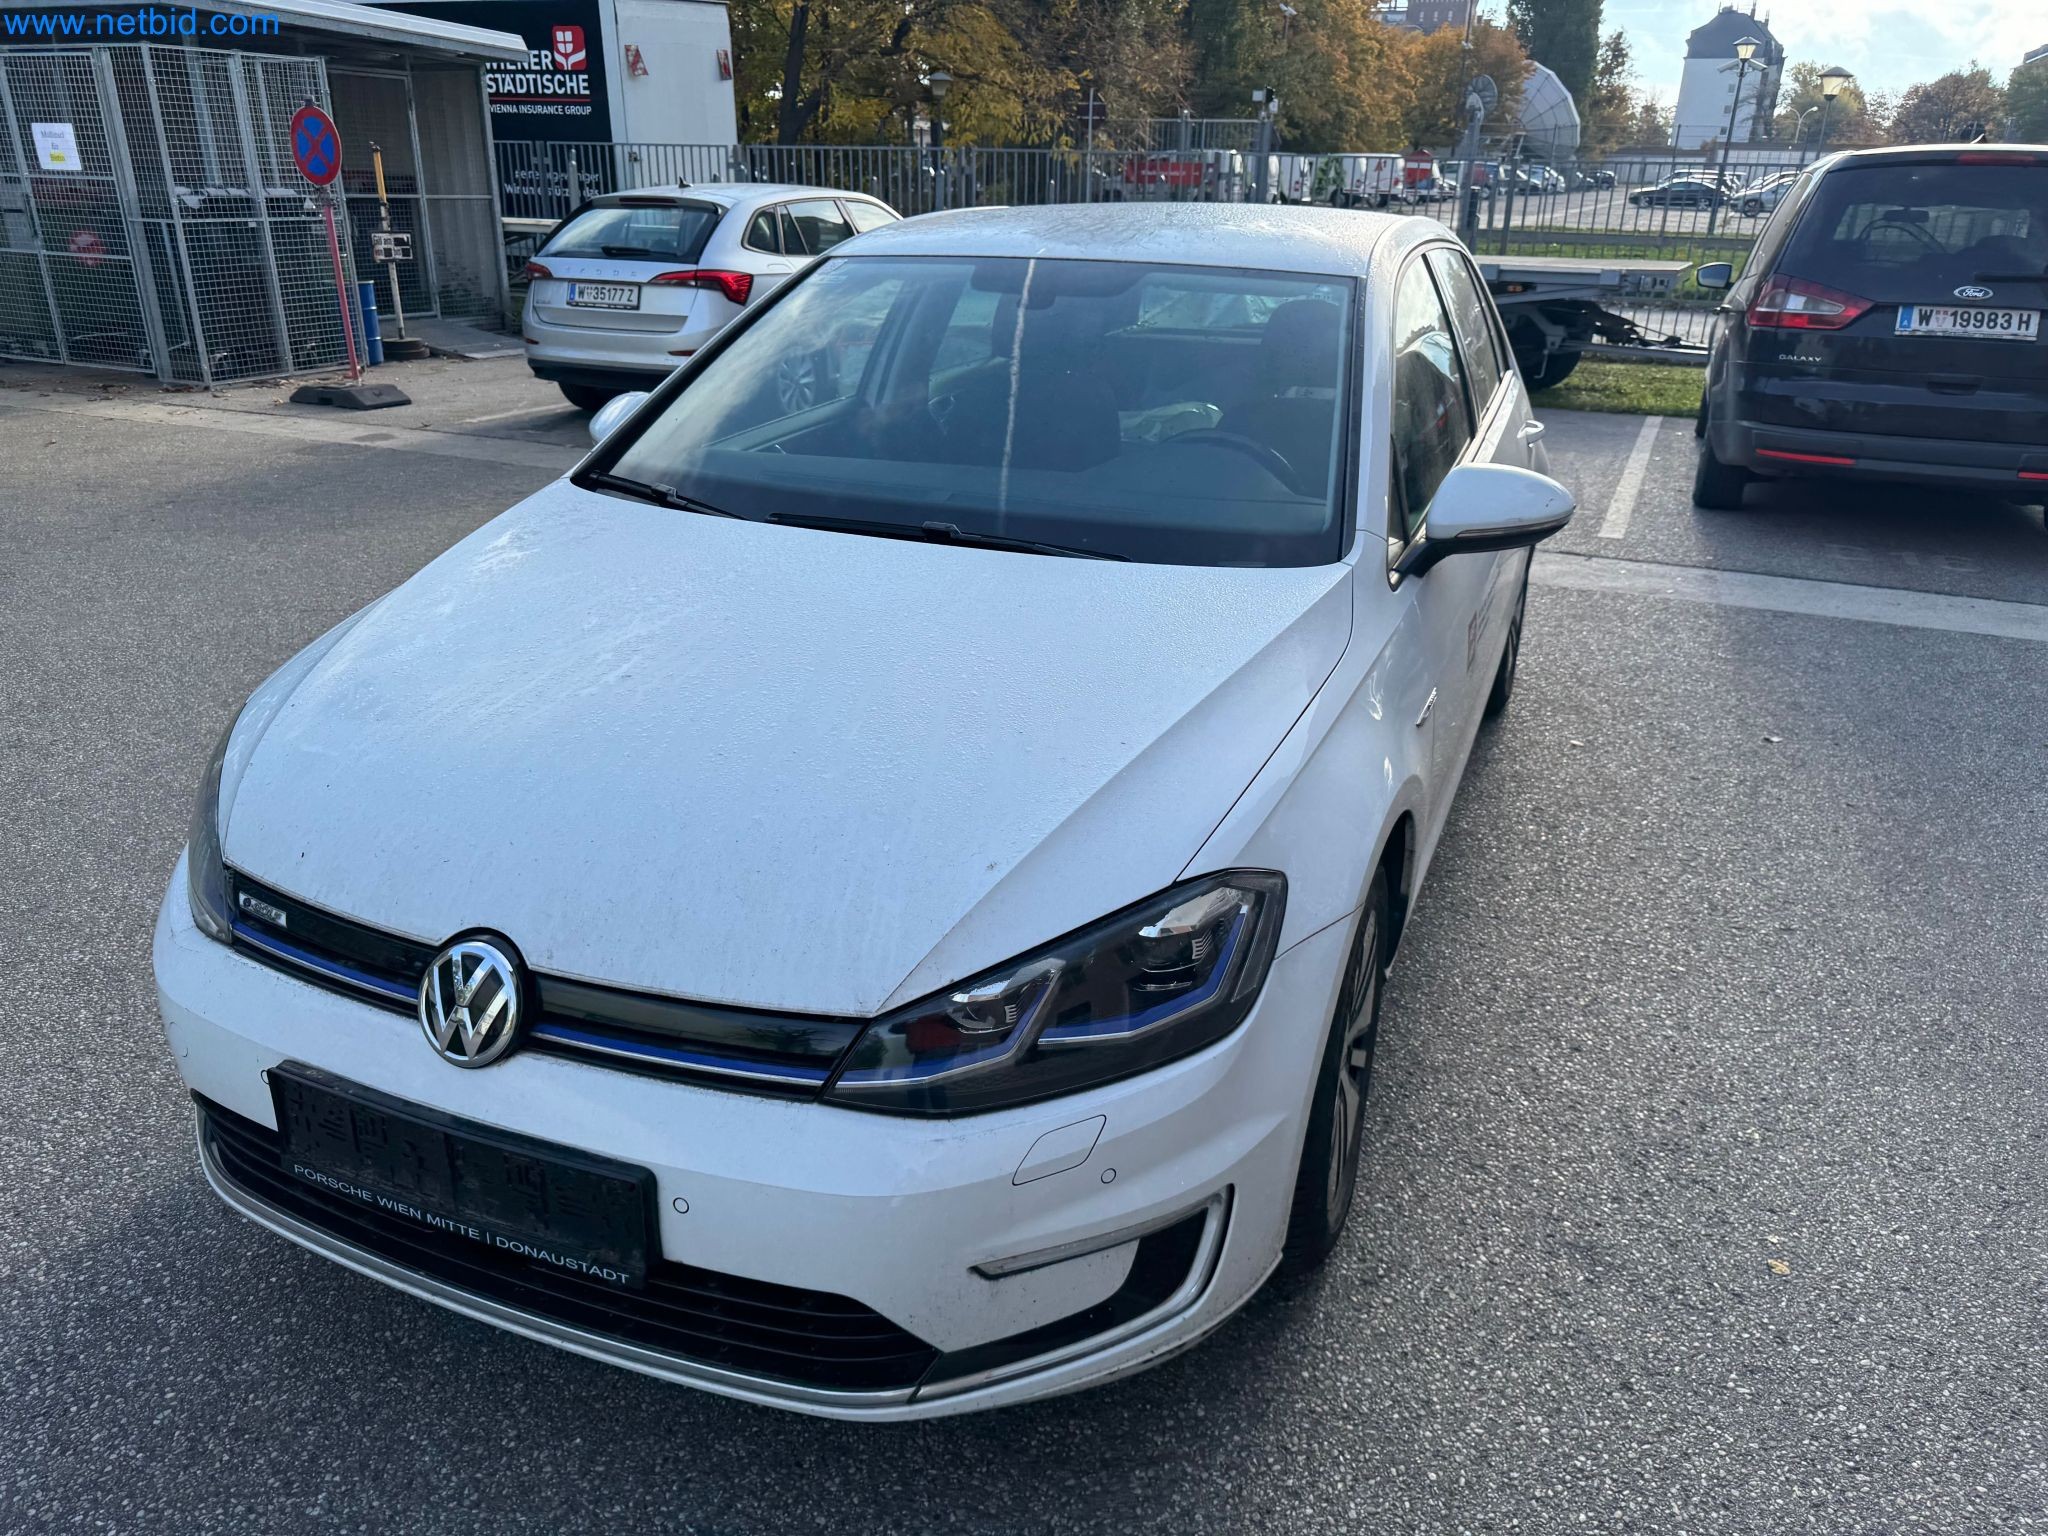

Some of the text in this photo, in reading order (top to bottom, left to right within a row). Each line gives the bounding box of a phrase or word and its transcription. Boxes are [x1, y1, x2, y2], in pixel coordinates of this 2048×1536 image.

[486, 73, 590, 95] STÄDTISCHE
[490, 104, 592, 115] VIENNA INSURANCE GROUP
[577, 285, 588, 300] W
[1918, 308, 2032, 332] W 19983 H
[294, 1164, 374, 1202] PORSCHE
[376, 1194, 422, 1221] WIEN
[426, 1213, 480, 1241] MITTE
[496, 1235, 630, 1284] DONAUSTADT
